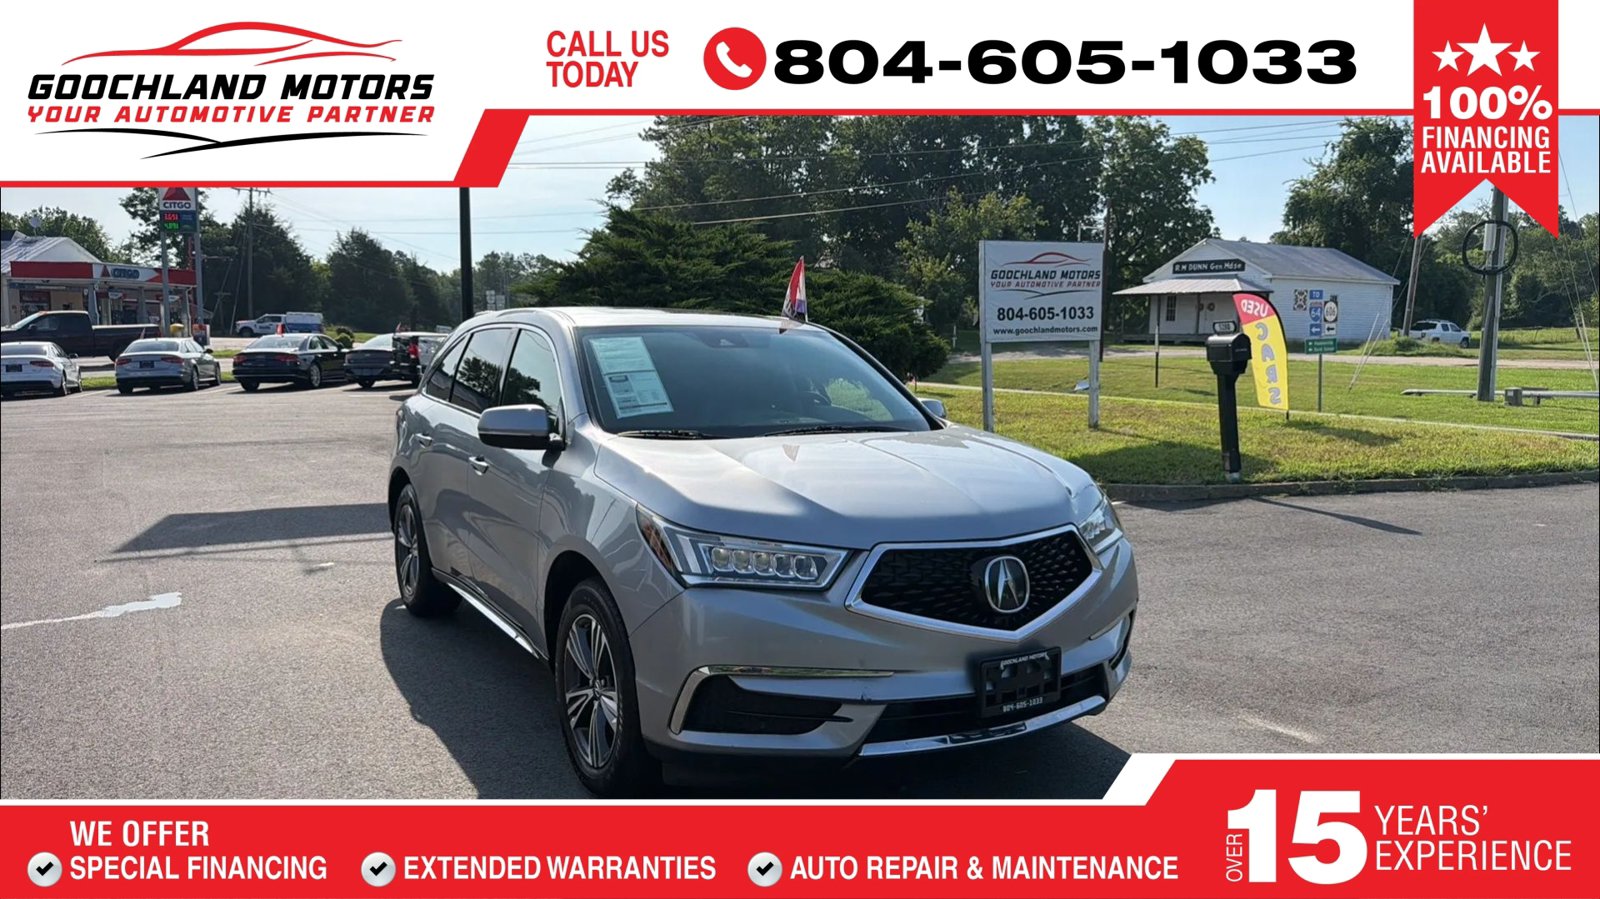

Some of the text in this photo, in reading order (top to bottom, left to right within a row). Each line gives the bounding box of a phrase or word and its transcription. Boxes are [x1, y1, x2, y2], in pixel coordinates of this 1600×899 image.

[163, 201, 191, 209] CITGO
[1188, 263, 1208, 271] DUNN
[990, 270, 1101, 280] GOOCHLAND MOTORS
[996, 306, 1095, 321] 804-605-1033
[993, 326, 1099, 336] www.goochlandmotors.com
